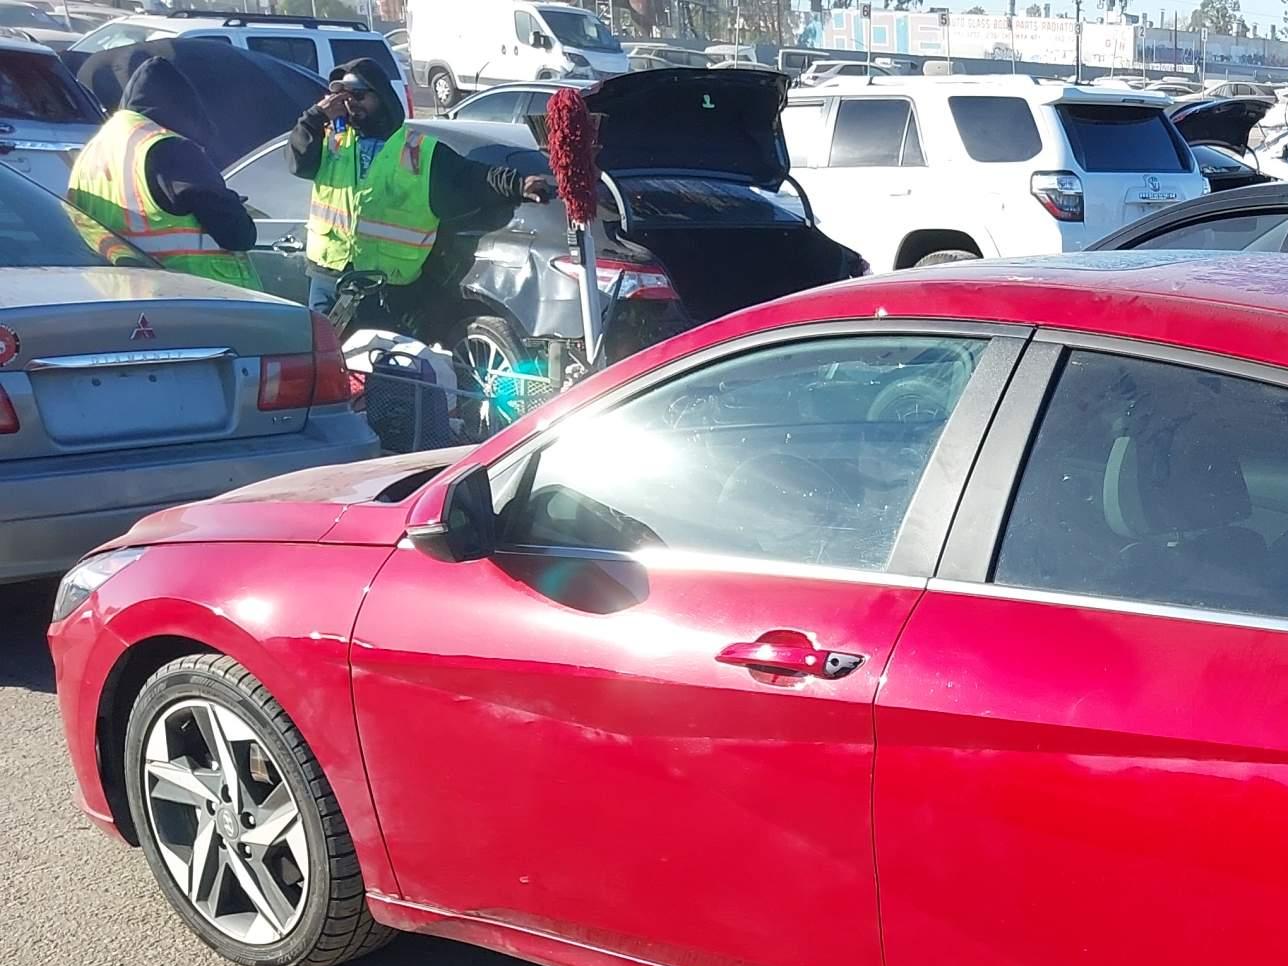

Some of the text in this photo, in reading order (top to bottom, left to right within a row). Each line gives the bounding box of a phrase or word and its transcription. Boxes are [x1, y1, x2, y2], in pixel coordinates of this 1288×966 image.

[862, 5, 869, 17] 6
[940, 13, 947, 25] 5
[1015, 20, 1038, 31] PARTS
[1074, 24, 1081, 34] 3
[1139, 26, 1146, 37] 2
